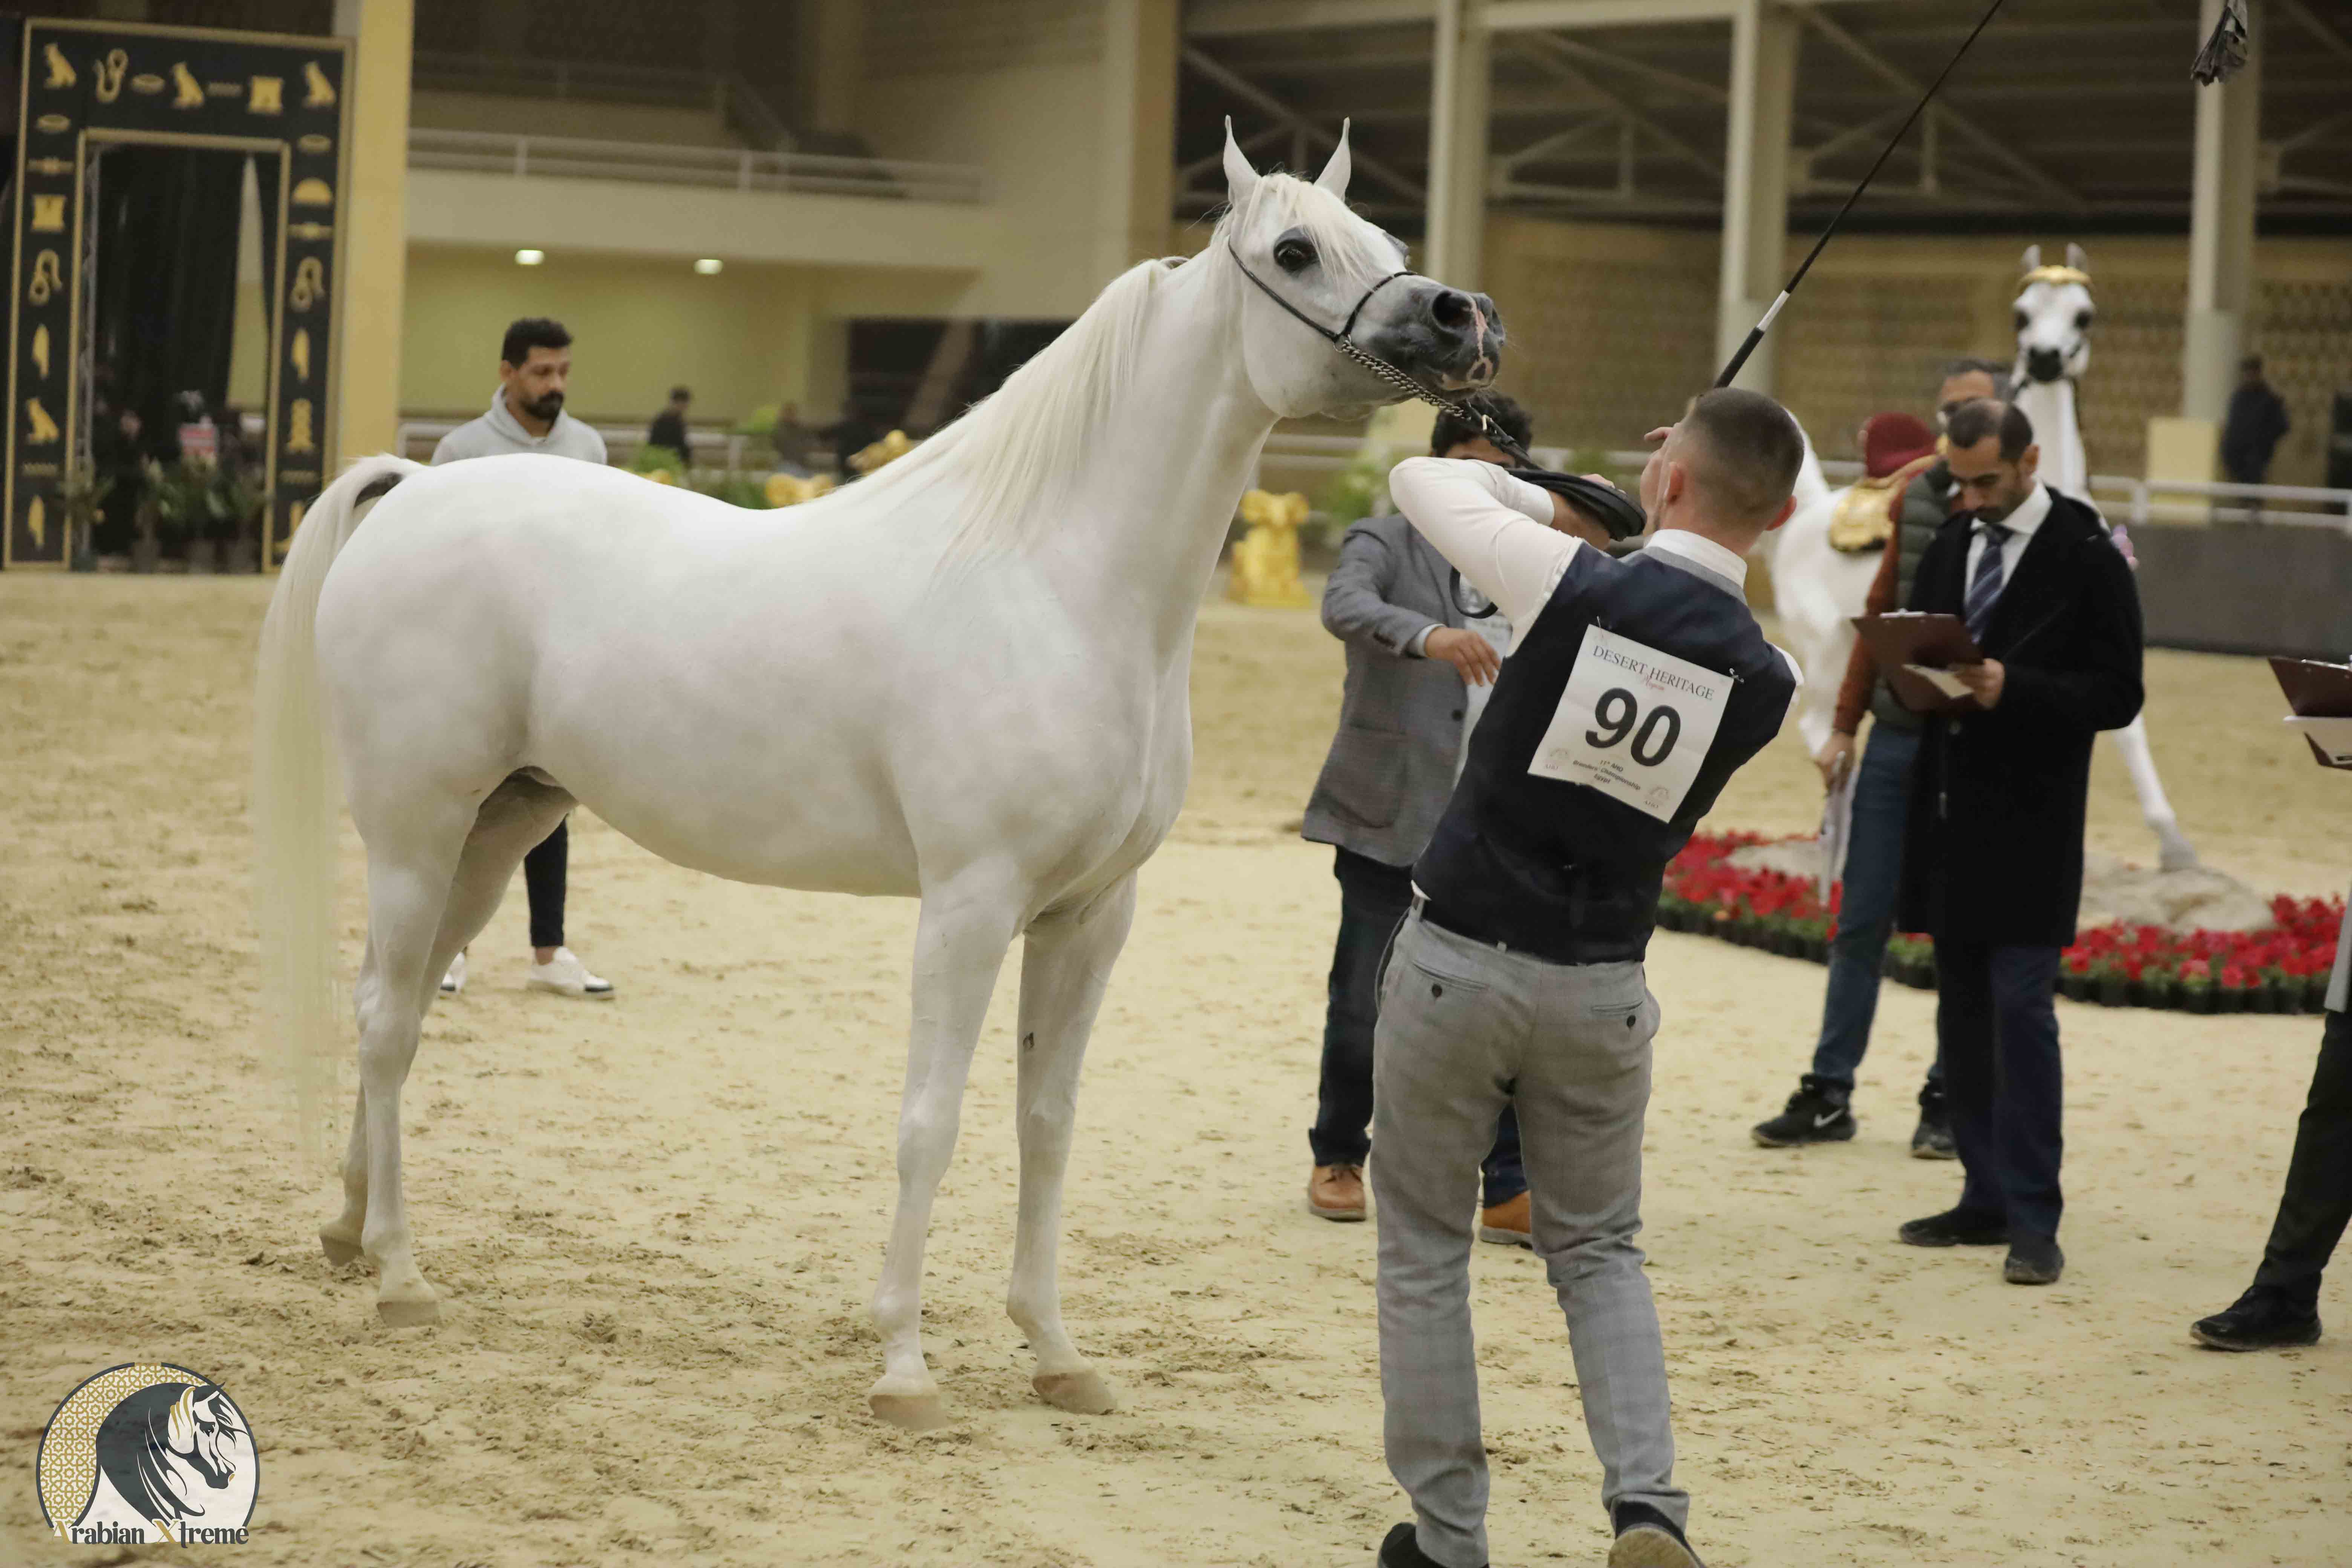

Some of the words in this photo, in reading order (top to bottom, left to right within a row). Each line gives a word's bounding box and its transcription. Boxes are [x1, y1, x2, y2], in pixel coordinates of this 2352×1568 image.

[1593, 645, 1648, 674] DESERT
[1649, 667, 1715, 700] HERITAGE
[1585, 688, 1681, 767] 90
